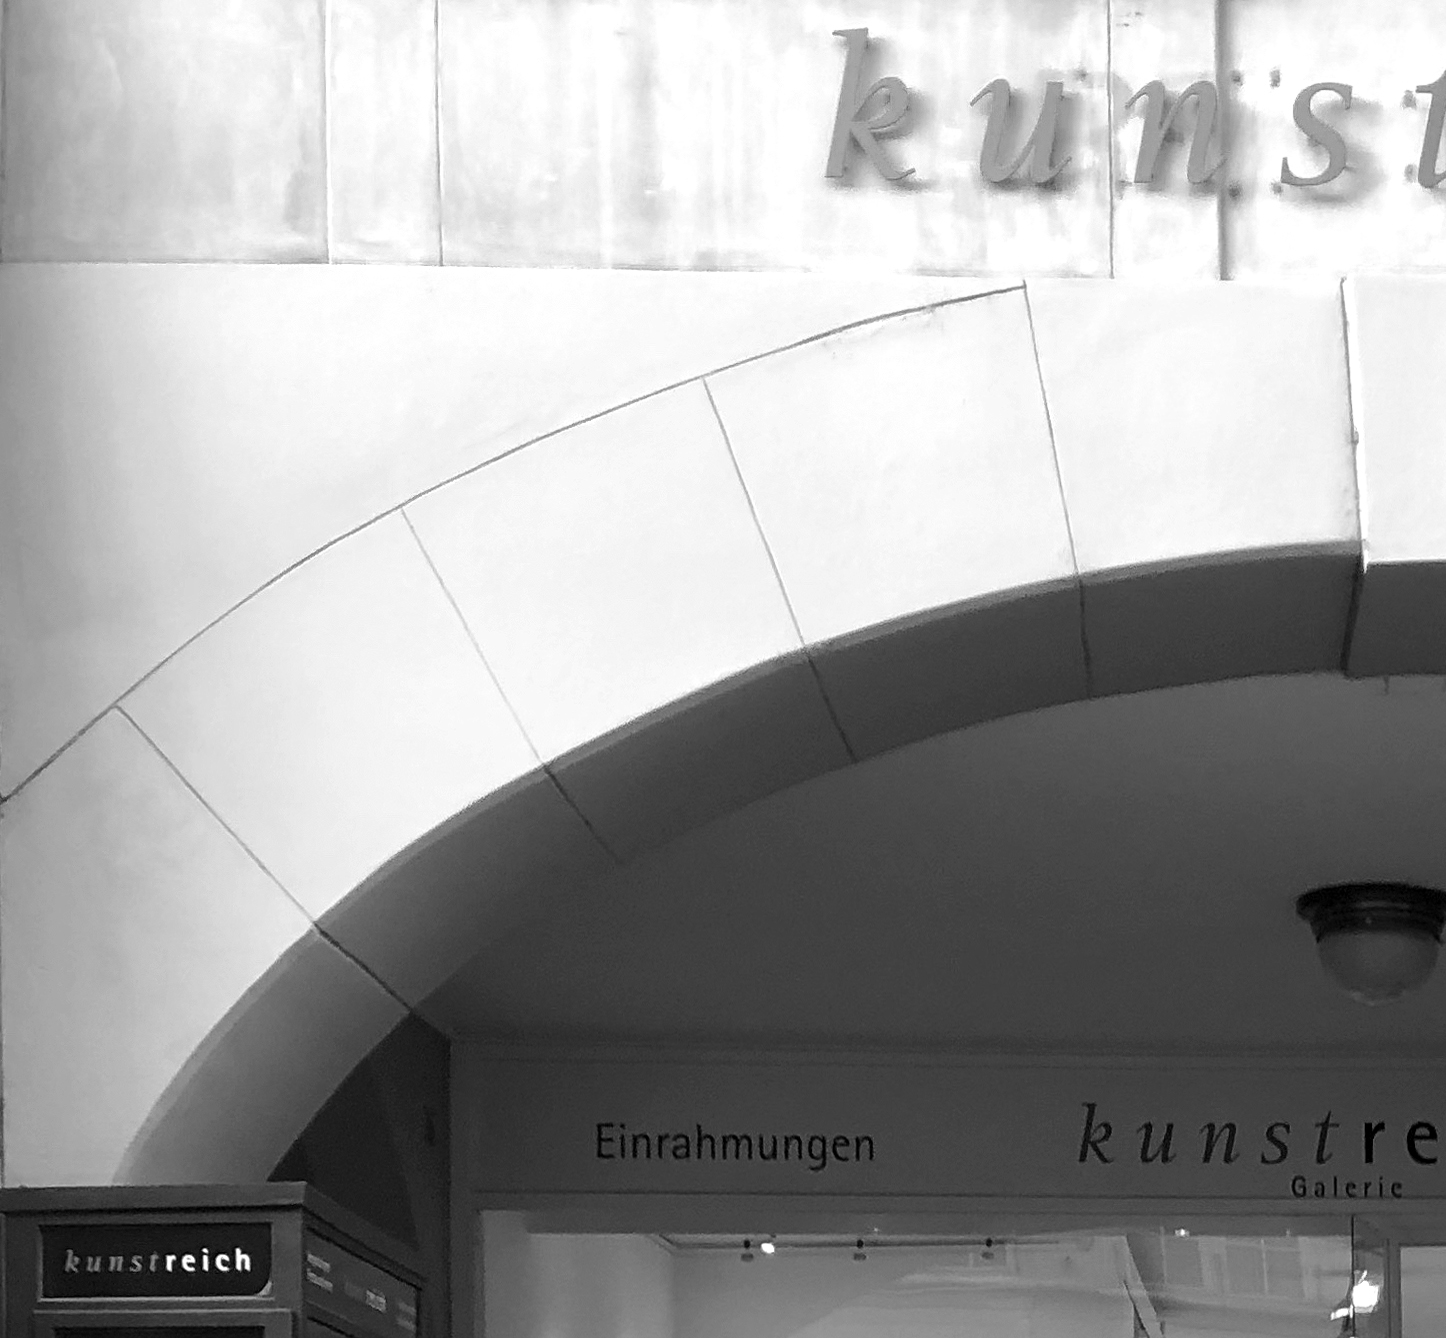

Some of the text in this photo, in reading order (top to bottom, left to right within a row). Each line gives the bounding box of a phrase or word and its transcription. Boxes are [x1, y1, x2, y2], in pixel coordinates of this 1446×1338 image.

[595, 1122, 876, 1172] Einrahmungen
[1290, 1175, 1404, 1200] Galerie
[63, 1247, 252, 1273] kunstreich
